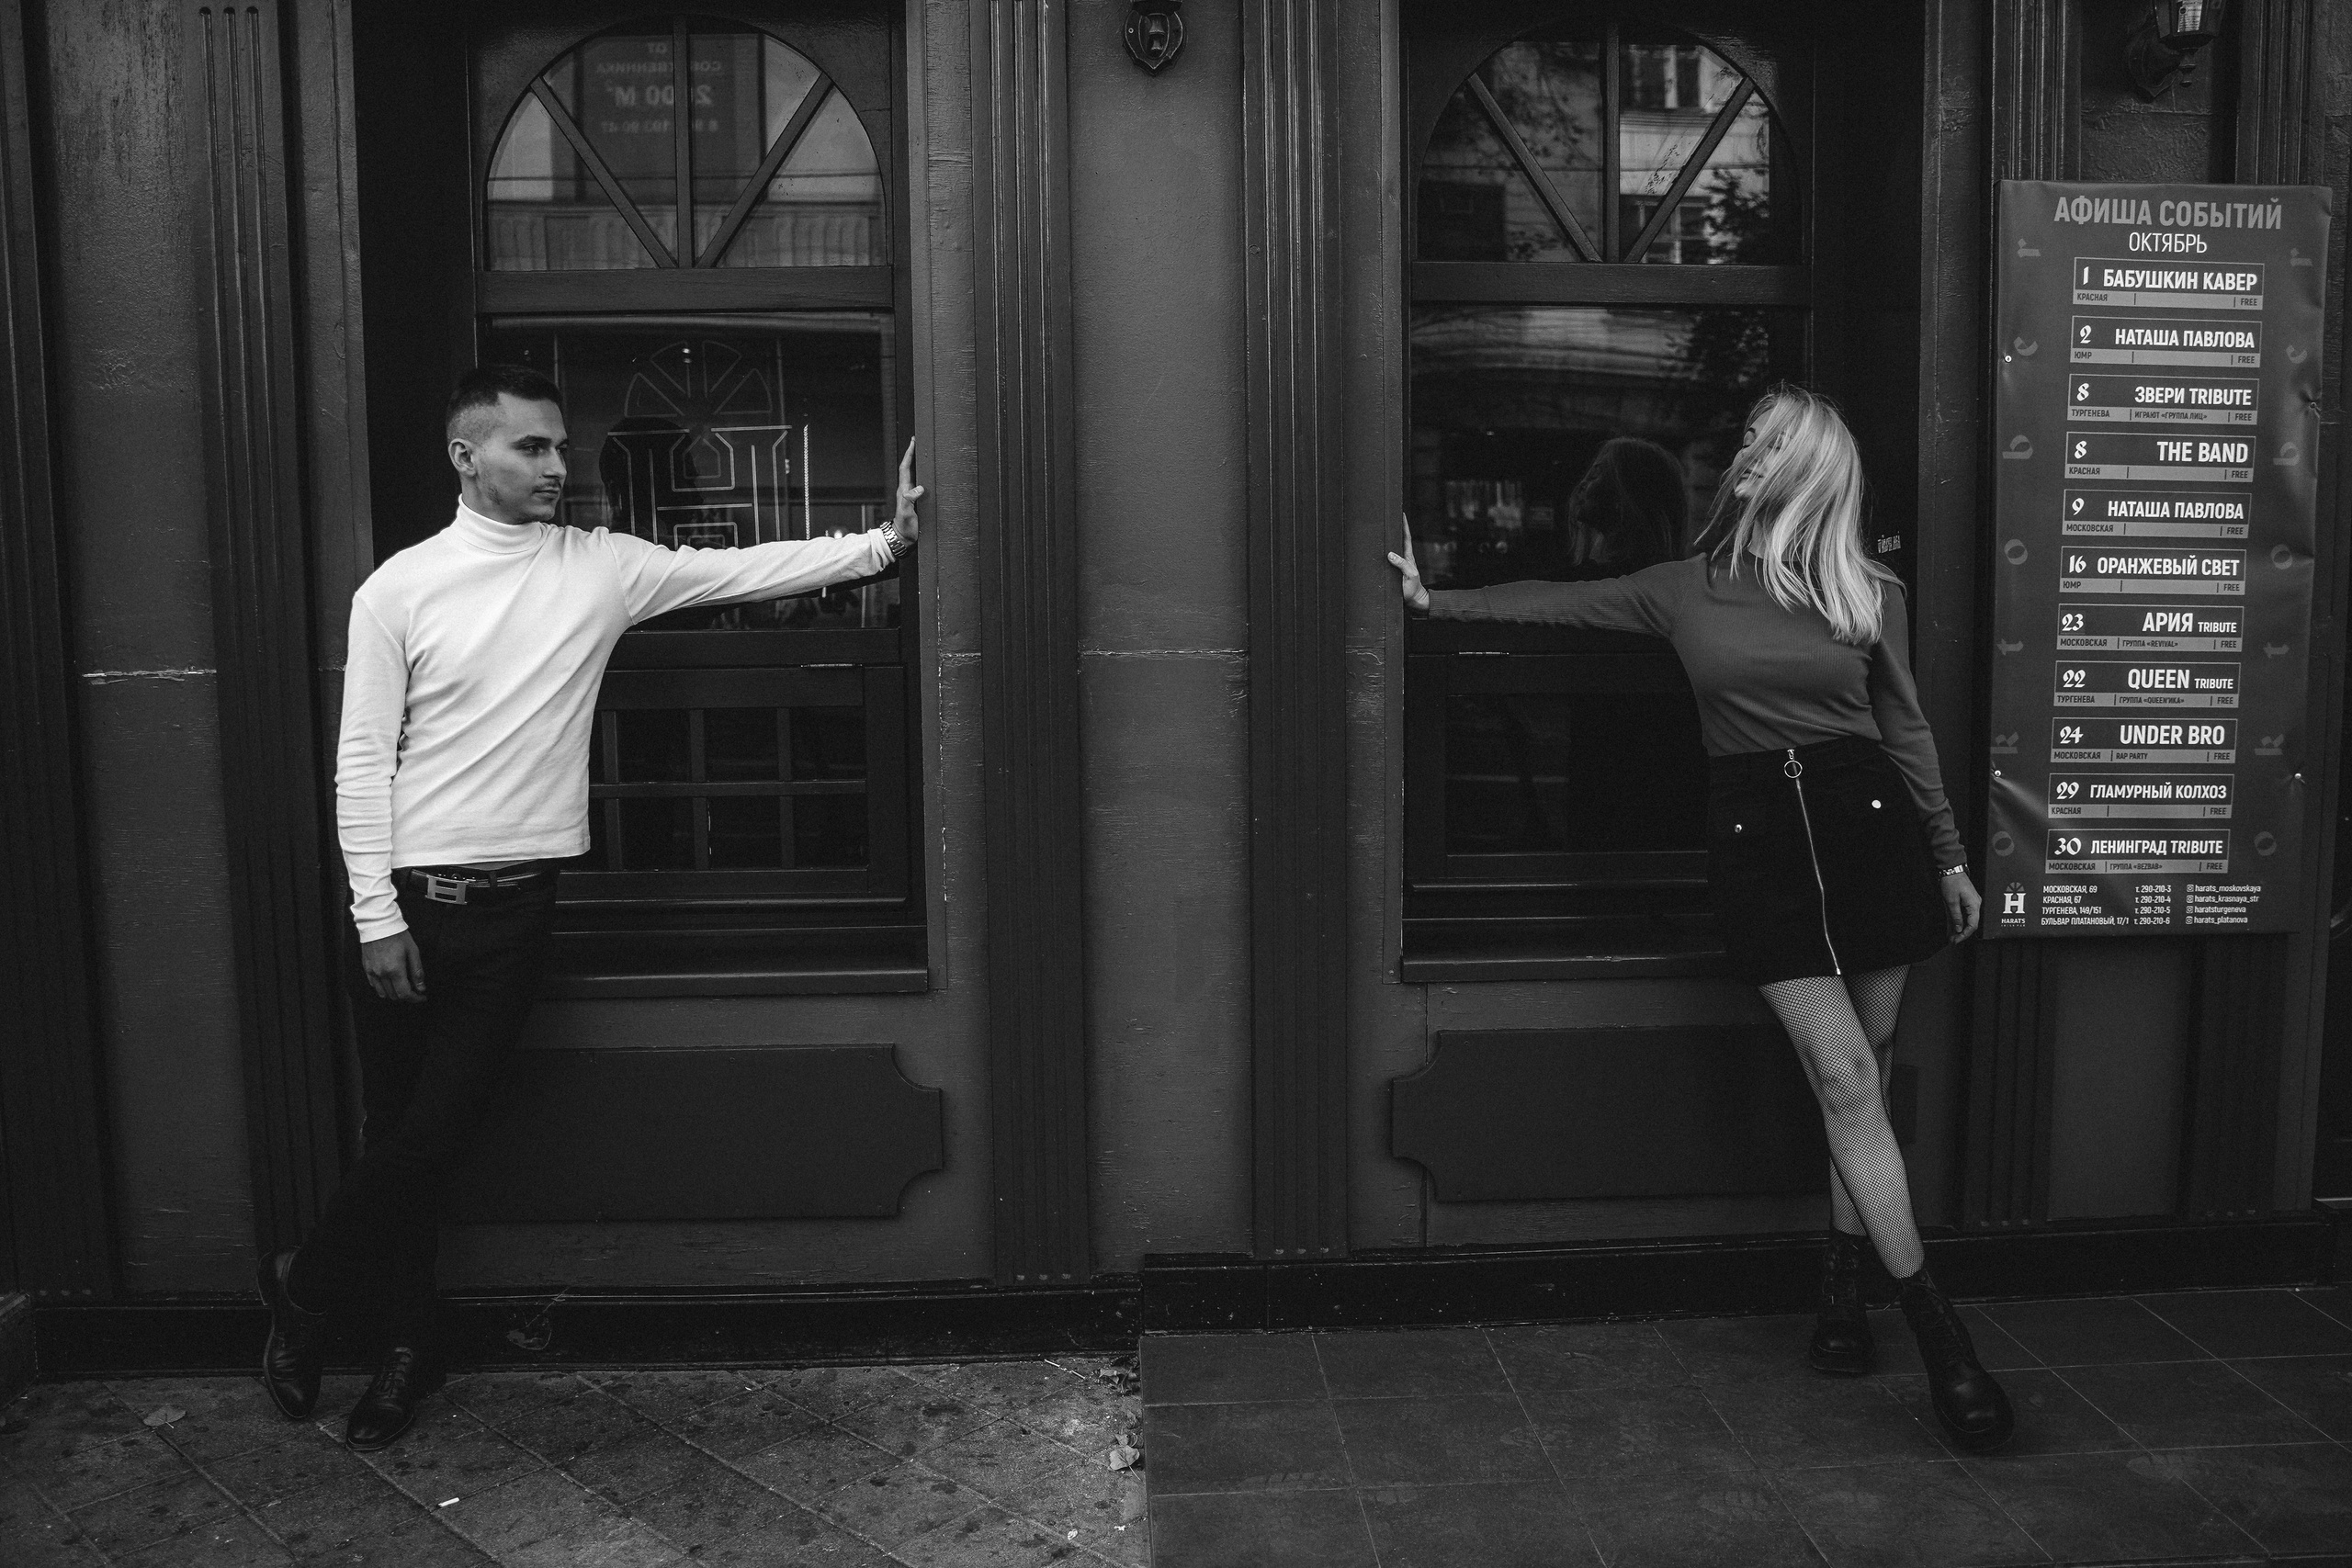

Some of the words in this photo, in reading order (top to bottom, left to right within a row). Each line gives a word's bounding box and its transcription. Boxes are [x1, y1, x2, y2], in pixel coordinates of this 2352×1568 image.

[2054, 196, 2152, 226] АФИША
[2159, 197, 2282, 229] СОБЫТИЙ
[2129, 231, 2207, 253] ОКТЯБРЬ
[2083, 266, 2089, 285] 1
[2103, 268, 2198, 289] БАБУШКИН
[2203, 272, 2257, 291] КАВЕР
[2077, 293, 2108, 302] КРАСНАЯ
[2241, 298, 2257, 306] FREE
[2080, 325, 2092, 344] 2
[2115, 329, 2178, 345] НАТАША
[2183, 331, 2255, 348] ПАВЛОВА
[2075, 351, 2092, 360] ЮМР
[2238, 355, 2255, 364] FREE
[2076, 383, 2089, 401] 8
[2134, 386, 2184, 403] ЗВЕРИ
[2189, 388, 2252, 405] TRIBUTE
[2072, 409, 2109, 418] ТУРГЕНЕВА
[2235, 412, 2252, 421] FREE
[2074, 441, 2086, 459] 8
[2157, 441, 2192, 462] THE
[2199, 443, 2248, 463] BAND
[2069, 467, 2100, 475] КРАСНАЯ
[2231, 469, 2248, 479] FREE
[2072, 498, 2085, 515] 9
[2108, 501, 2169, 518] НАТАША
[2174, 502, 2244, 519] ПАВЛОВА
[2066, 524, 2113, 533] МОСКОВСКАЯ
[2227, 526, 2244, 535] FREE
[2069, 555, 2086, 573] 16
[2098, 556, 2197, 574] ОРАНЖЕВЫЙ
[2202, 558, 2240, 576] СВЕТ
[2063, 581, 2081, 589] ЮМР
[2223, 583, 2240, 592] FREE
[2062, 614, 2084, 631] 23
[2143, 613, 2193, 631] АРИЯ
[2198, 622, 2237, 633] TRIBUTE
[2060, 638, 2108, 647] МОСКОВСКАЯ
[2122, 639, 2144, 648] ГРУППА
[2221, 640, 2237, 649] FREE
[2063, 670, 2086, 687] 22
[2128, 669, 2189, 689] QUEEN
[2195, 678, 2233, 689] TRIBUTE
[2057, 695, 2095, 704] ТУРГЕНЕВА
[2120, 696, 2142, 705] ГРУППА
[2217, 696, 2233, 705] FREE
[2060, 726, 2084, 744] 24
[2120, 725, 2182, 745] UNDER
[2188, 726, 2224, 744] BRO
[2054, 751, 2100, 760] МОСКОВСКАЯ
[2213, 752, 2230, 761] FREE
[2056, 782, 2079, 799] 29
[2090, 781, 2172, 799] ГЛАМУРНЫЙ
[2176, 784, 2226, 799] КОЛХОЗ
[2052, 807, 2082, 816] КРАСНАЯ
[2210, 807, 2226, 816] FREE
[2054, 837, 2081, 855] 30
[2091, 840, 2166, 856] ЛЕНИНГРАД
[2171, 840, 2222, 854] TRIBUTE
[2049, 862, 2096, 871] МОСКОВСКАЯ
[2109, 863, 2132, 871] ГРУППА
[2206, 863, 2222, 871] FREE
